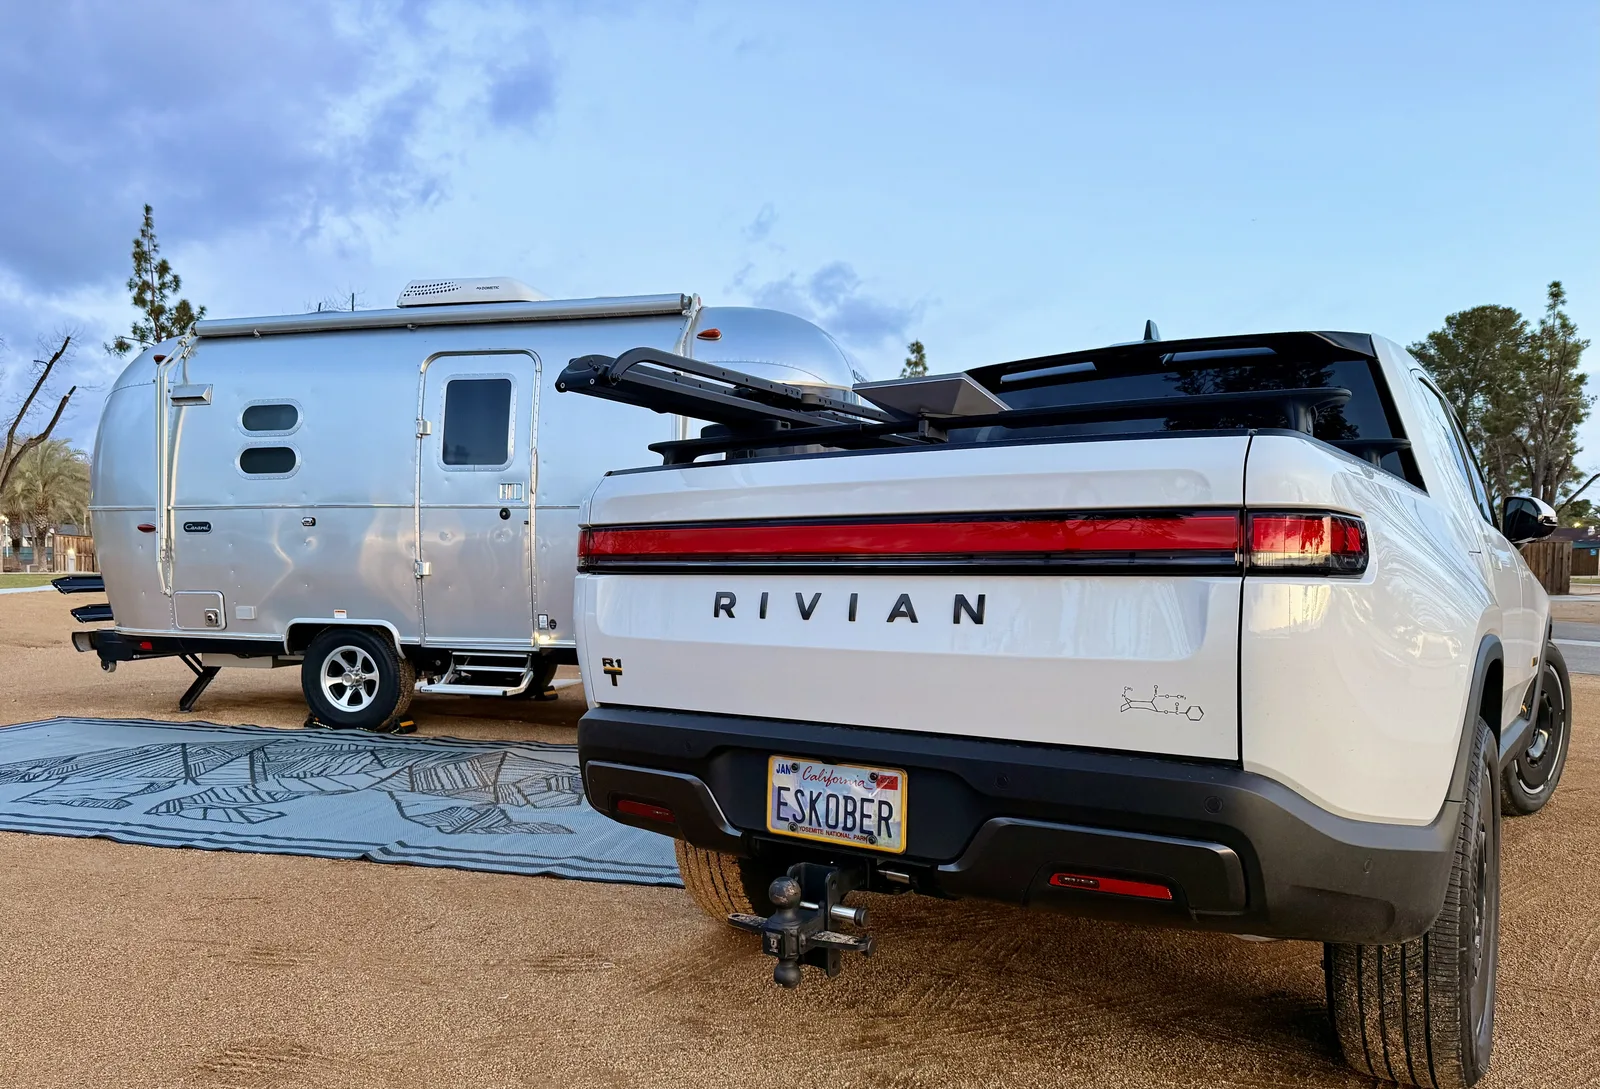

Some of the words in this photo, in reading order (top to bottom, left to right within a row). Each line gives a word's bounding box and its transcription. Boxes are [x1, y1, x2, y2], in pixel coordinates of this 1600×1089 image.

[713, 591, 987, 625] RIVIAN
[776, 763, 791, 775] JAN
[802, 765, 873, 790] California
[776, 786, 894, 838] ESKOBER
[799, 826, 824, 835] YOSEMITE
[826, 830, 852, 840] NATIONAL
[853, 835, 868, 843] PARK
